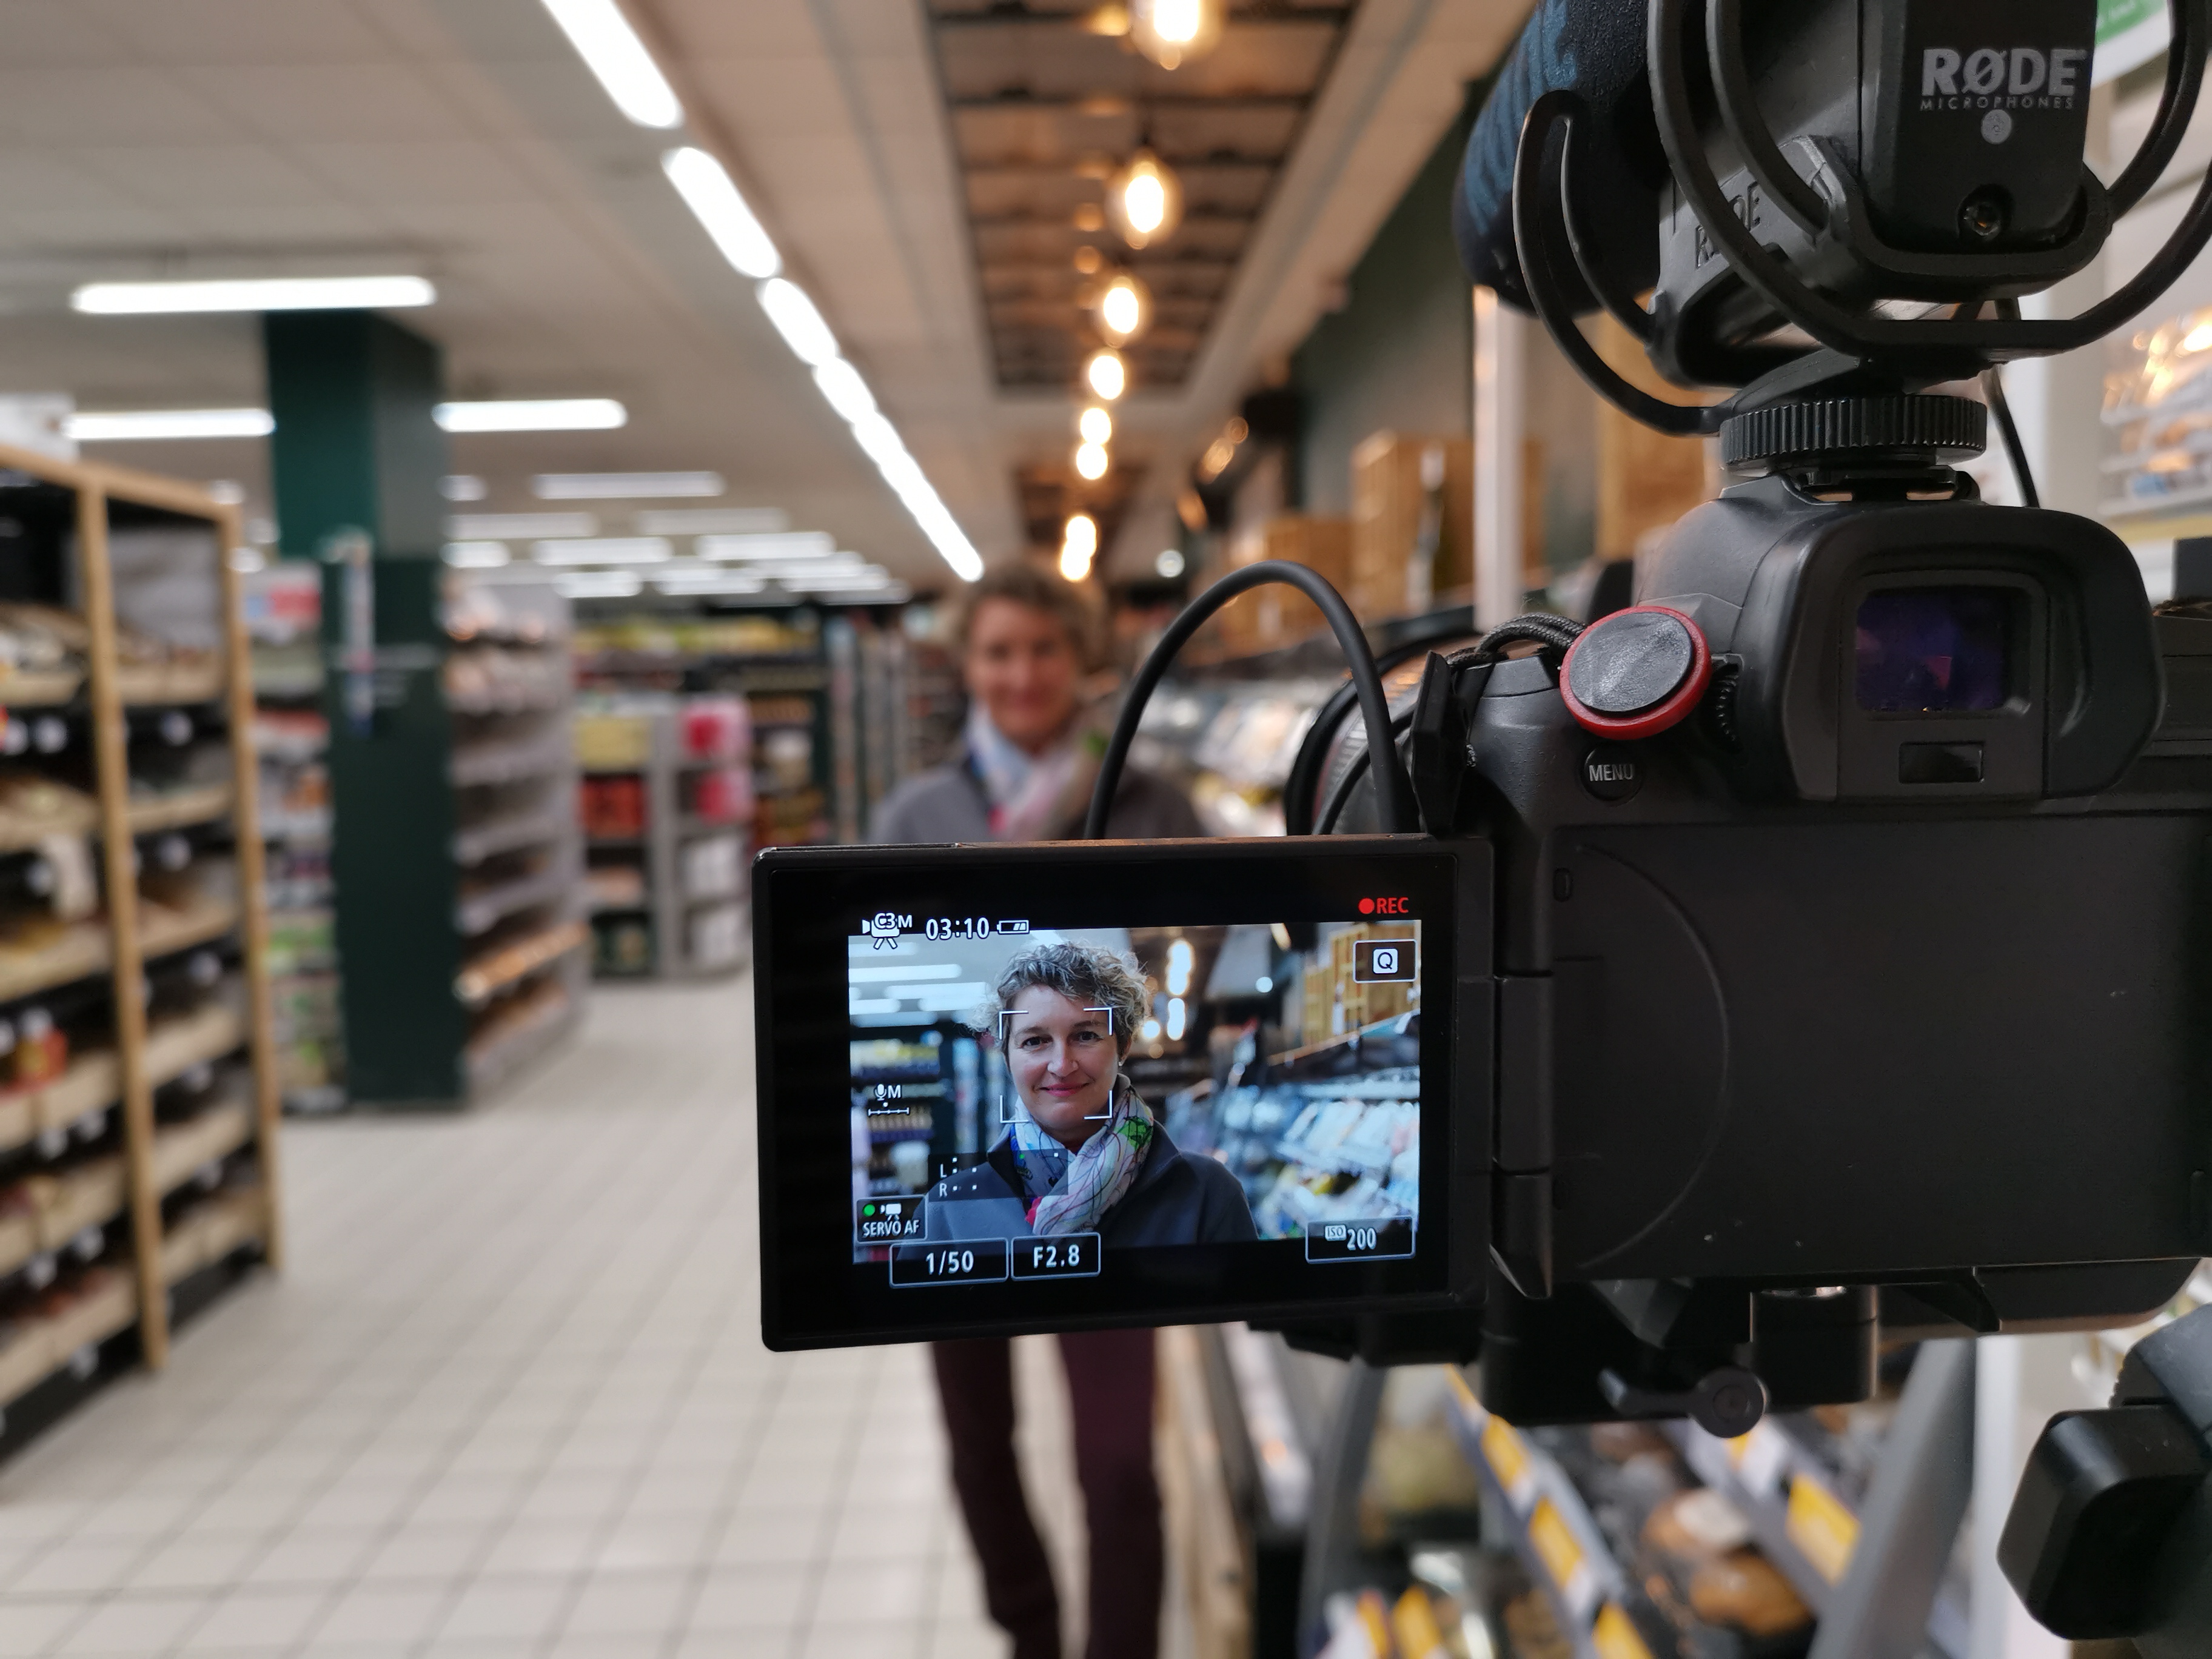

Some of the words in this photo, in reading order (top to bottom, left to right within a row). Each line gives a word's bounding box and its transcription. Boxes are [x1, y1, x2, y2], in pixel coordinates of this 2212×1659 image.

[1920, 96, 2074, 111] MICROPHONES
[1589, 764, 1634, 781] MENU
[1376, 897, 1409, 914] REC
[925, 917, 990, 940] 03:10
[1377, 952, 1392, 970] Q
[939, 1164, 946, 1178] L
[939, 1183, 948, 1198] R
[862, 1219, 902, 1237] SERVO
[904, 1219, 920, 1235] AF
[1327, 1227, 1344, 1238] ISO
[1347, 1227, 1377, 1251] 200
[925, 1250, 974, 1276] 1/50
[1033, 1244, 1081, 1269] F2.8
